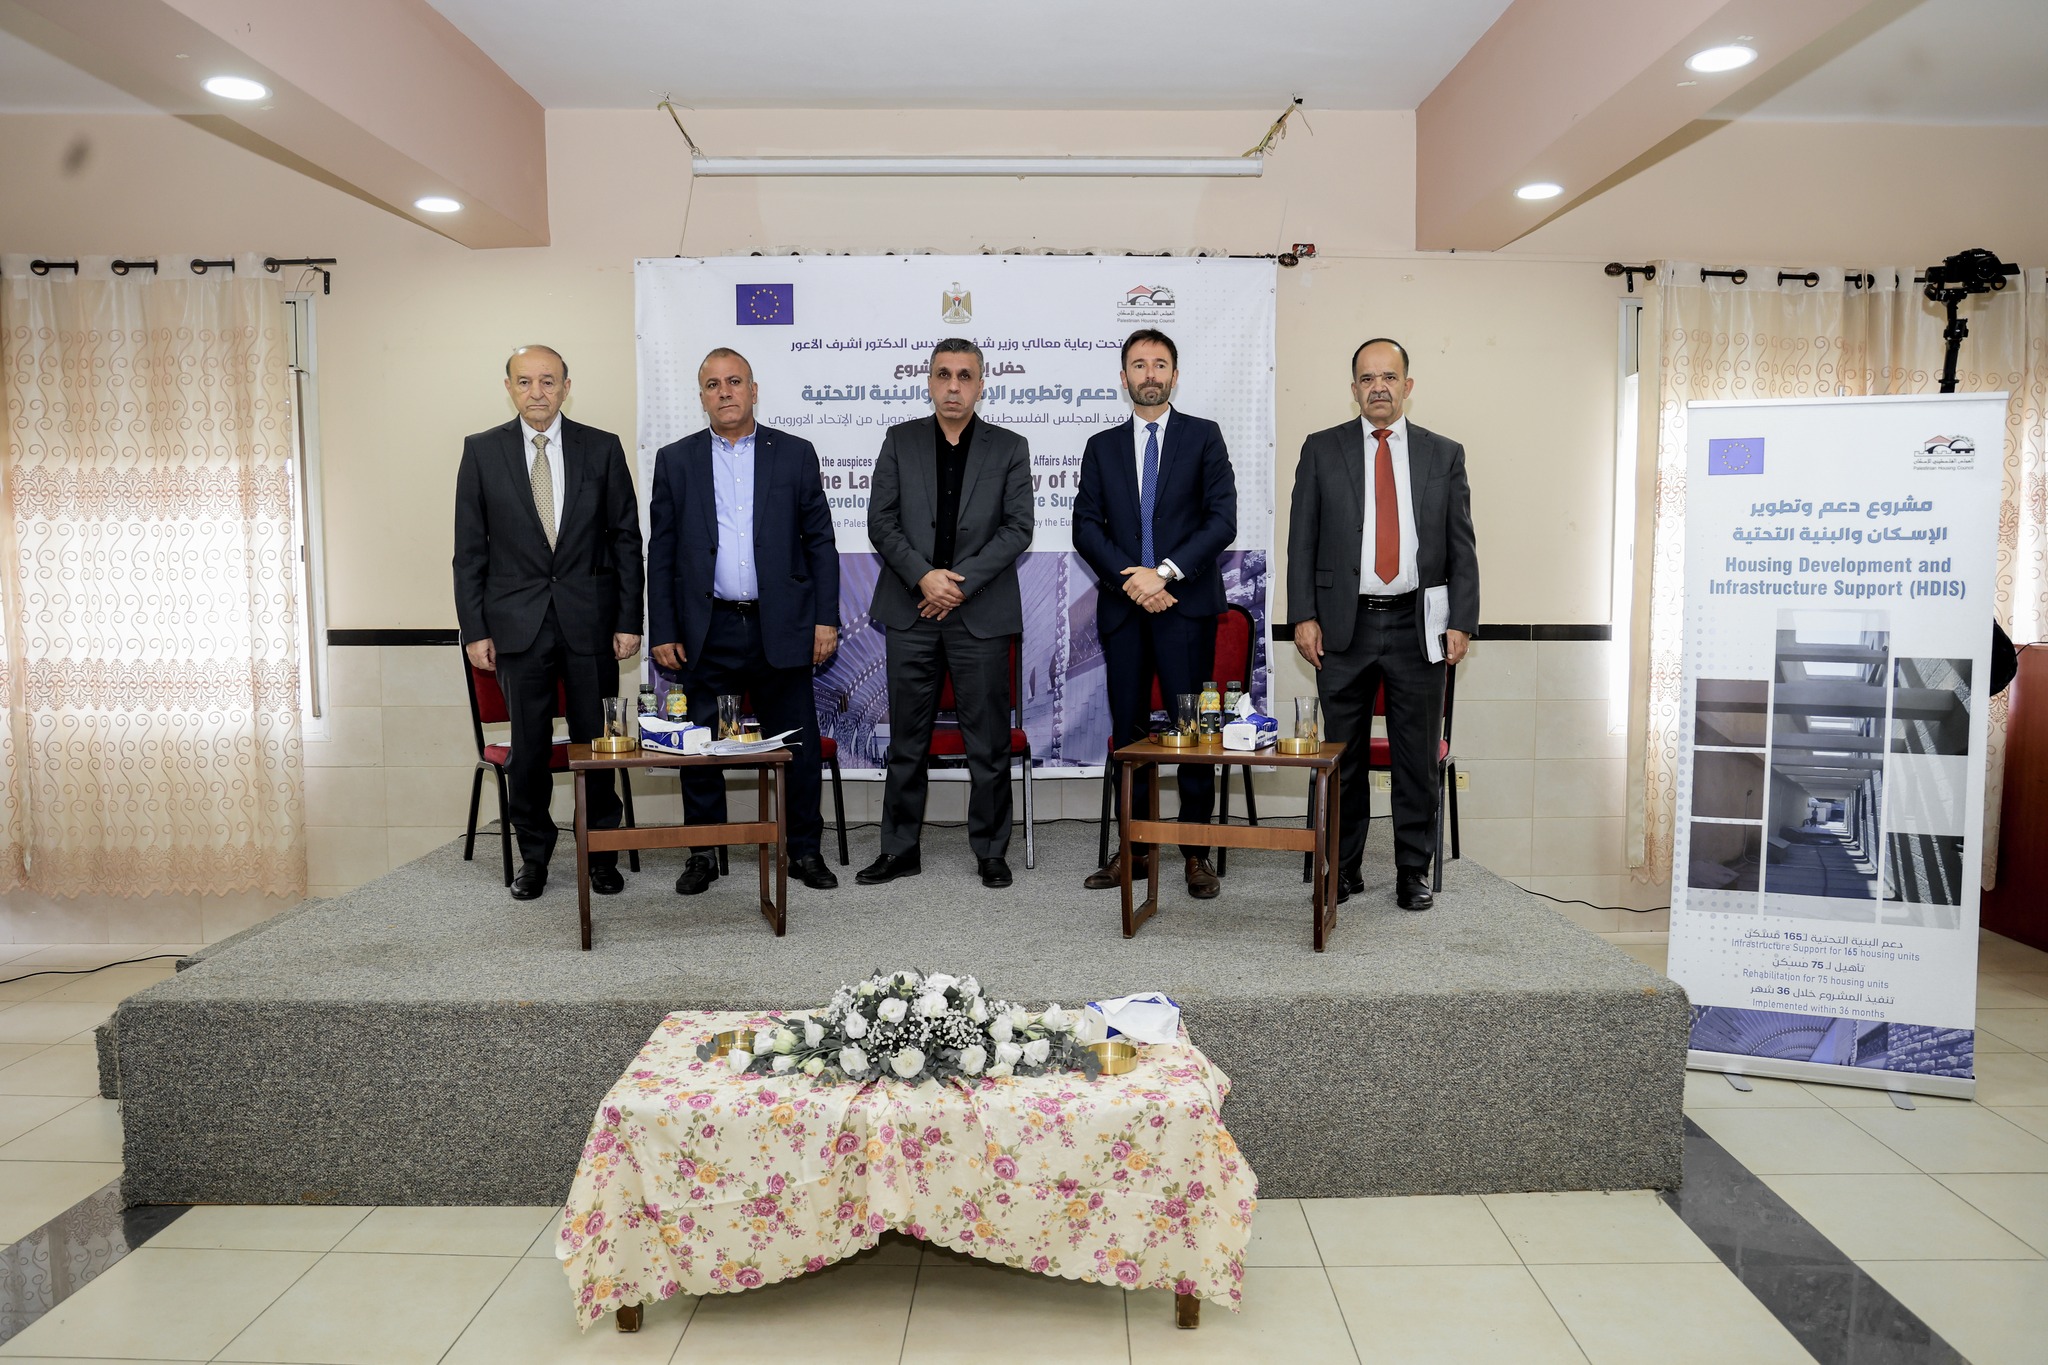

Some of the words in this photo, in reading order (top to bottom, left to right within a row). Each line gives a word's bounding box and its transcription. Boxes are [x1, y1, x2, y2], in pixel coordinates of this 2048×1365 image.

[826, 337, 862, 351] أشرف
[865, 338, 908, 351] الدكتور
[997, 338, 1018, 351] وزير
[1022, 338, 1061, 351] معالي
[1064, 338, 1092, 351] رعاية
[1096, 338, 1124, 349] تحت
[992, 361, 1026, 376] حفل
[801, 384, 865, 406] التحتية
[869, 384, 932, 405] والبنية
[1009, 384, 1073, 405] وتطوير
[1076, 388, 1118, 408] دعم
[855, 415, 873, 427] من
[1052, 412, 1099, 426] المجلس
[822, 456, 835, 467] the
[837, 455, 873, 470] auspices
[1033, 454, 1060, 466] Affairs
[1048, 470, 1067, 488] of
[1750, 498, 1813, 517] وتطوير
[1818, 501, 1860, 519] دعم
[1866, 494, 1933, 519] مشروع
[1045, 518, 1058, 527] the
[1732, 526, 1795, 545] التحتية
[1799, 526, 1863, 545] والبنية
[1725, 556, 1793, 575] Housing
[1799, 557, 1912, 576] Development
[1918, 557, 1951, 573] and
[1709, 579, 1828, 596] Infrastructure
[1833, 579, 1903, 599] Support
[1909, 580, 1966, 600] (HDIS)
[1744, 929, 1780, 939] مسكن
[1810, 934, 1849, 945] التحتية
[1731, 938, 1790, 951] Infrastructure
[1793, 943, 1827, 955] Support
[1829, 946, 1841, 955] for
[1844, 947, 1858, 956] 165
[1860, 948, 1895, 961] housing
[1898, 951, 1920, 961] units
[1851, 937, 1879, 949] البنية
[1881, 941, 1903, 949] دعم
[1772, 958, 1809, 968] مسكن
[1811, 960, 1824, 969] 75
[1834, 963, 1865, 973] تأهيل
[1742, 968, 1801, 981] Rehabilitation
[1803, 974, 1815, 982] for
[1818, 975, 1828, 984] 75
[1831, 976, 1865, 989] housing
[1867, 979, 1889, 989] units
[1750, 984, 1775, 994] شهر
[1776, 986, 1790, 995] 36
[1793, 988, 1816, 998] خلال
[1819, 991, 1862, 1002] المشروع
[1865, 994, 1895, 1005] تنفيذ
[1752, 998, 1808, 1012] Implemented
[1810, 1004, 1837, 1014] within
[1839, 1005, 1849, 1015] 36
[1852, 1008, 1885, 1018] months
